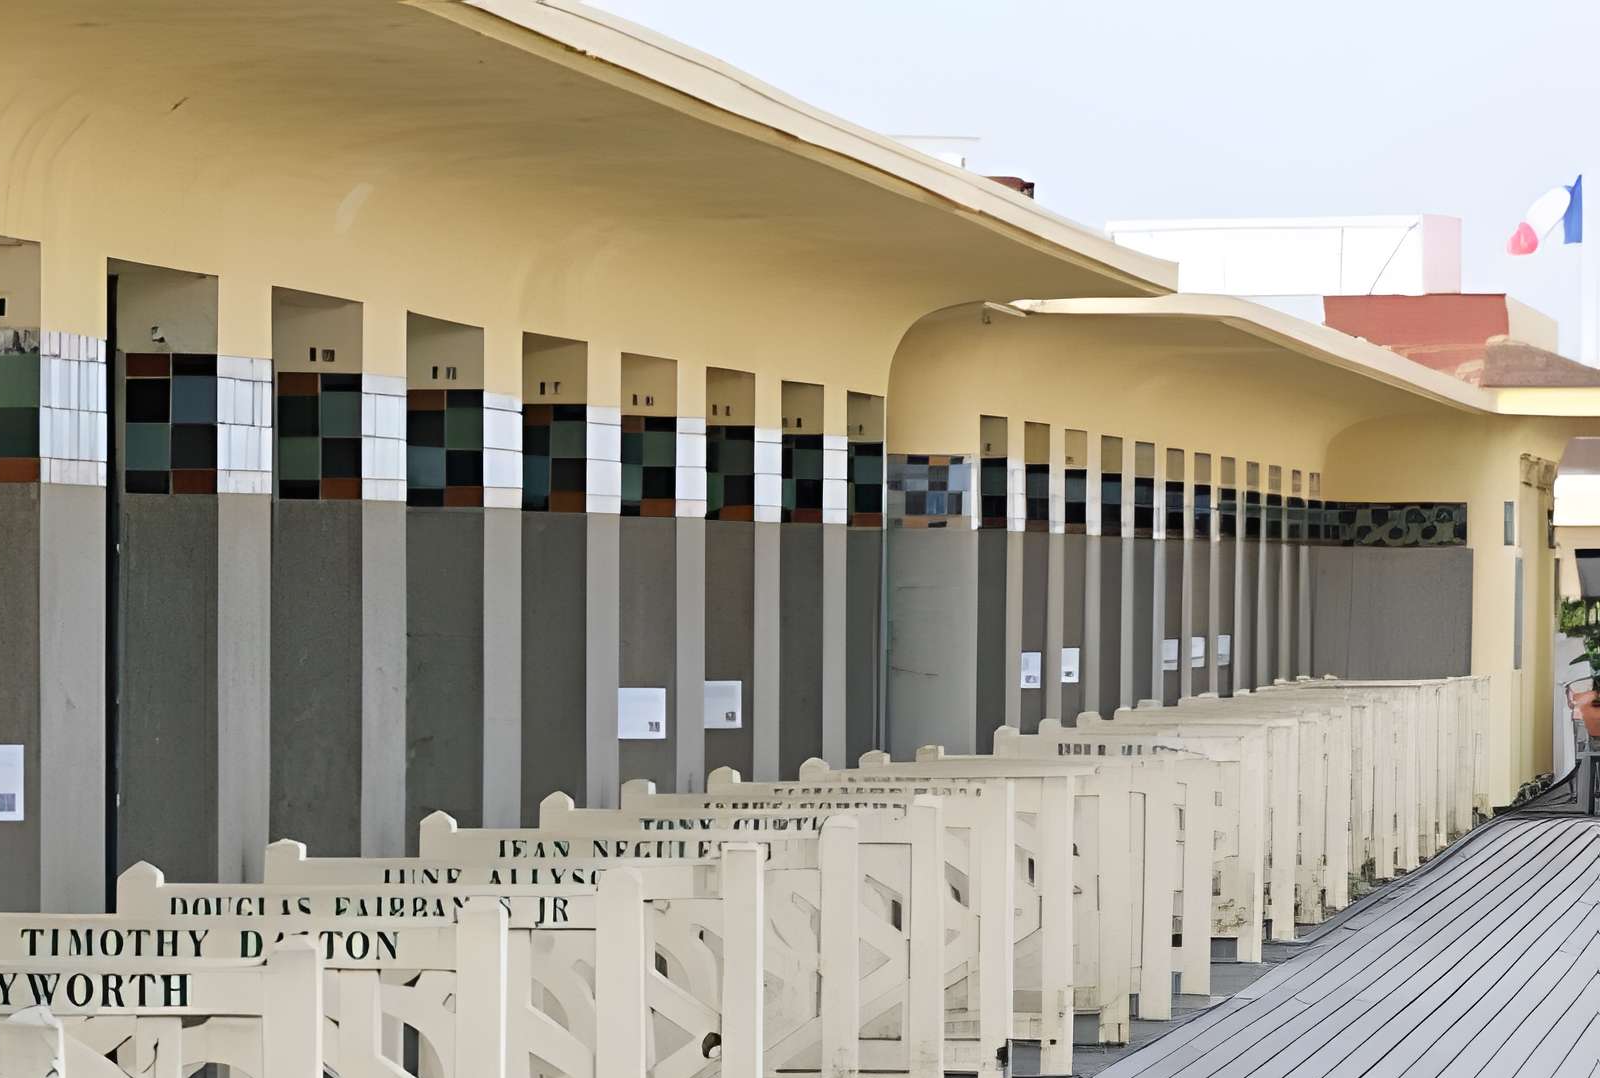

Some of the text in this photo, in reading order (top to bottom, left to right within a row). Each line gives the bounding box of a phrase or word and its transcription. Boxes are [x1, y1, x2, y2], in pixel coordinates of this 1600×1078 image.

[533, 896, 569, 927] JR
[20, 928, 399, 961] TIMOTHY DTON
